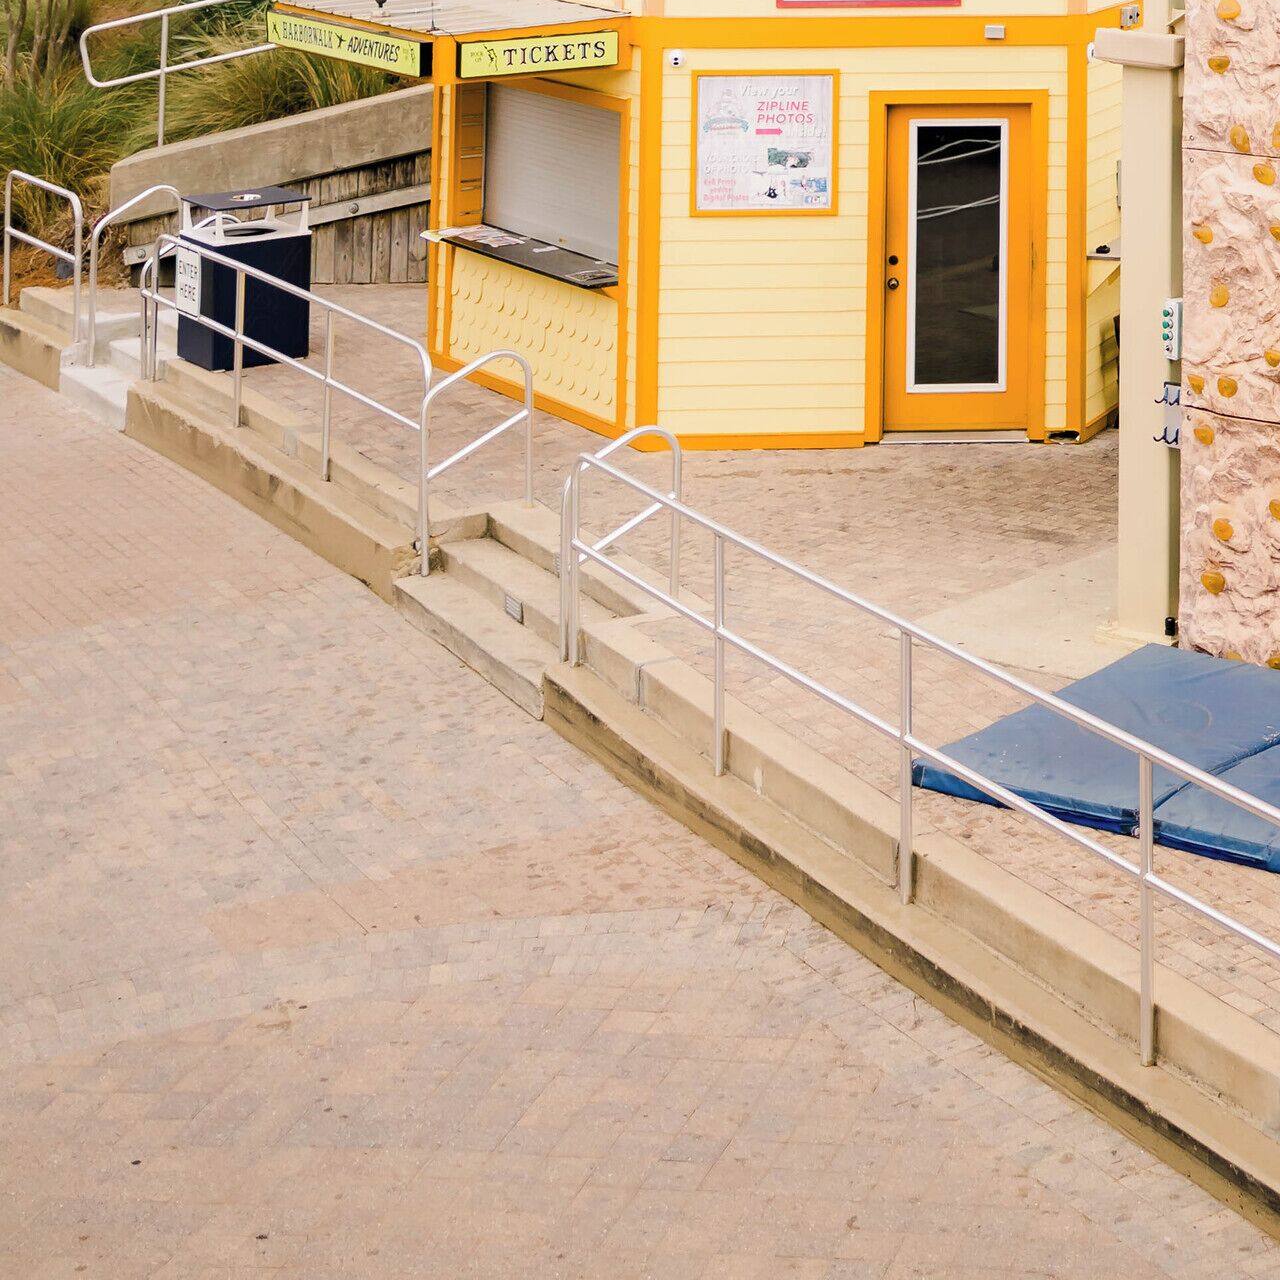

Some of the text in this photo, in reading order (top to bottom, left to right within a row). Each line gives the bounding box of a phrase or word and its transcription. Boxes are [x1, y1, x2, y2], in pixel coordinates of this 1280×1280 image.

[282, 21, 334, 49] HARBORWALK
[347, 36, 401, 63] ADVENTURES
[503, 41, 606, 66] TICKETS
[757, 101, 809, 111] ZIPLINE
[757, 113, 815, 124] PHOTOS
[178, 260, 198, 279] ENTER
[180, 283, 196, 302] HERE
